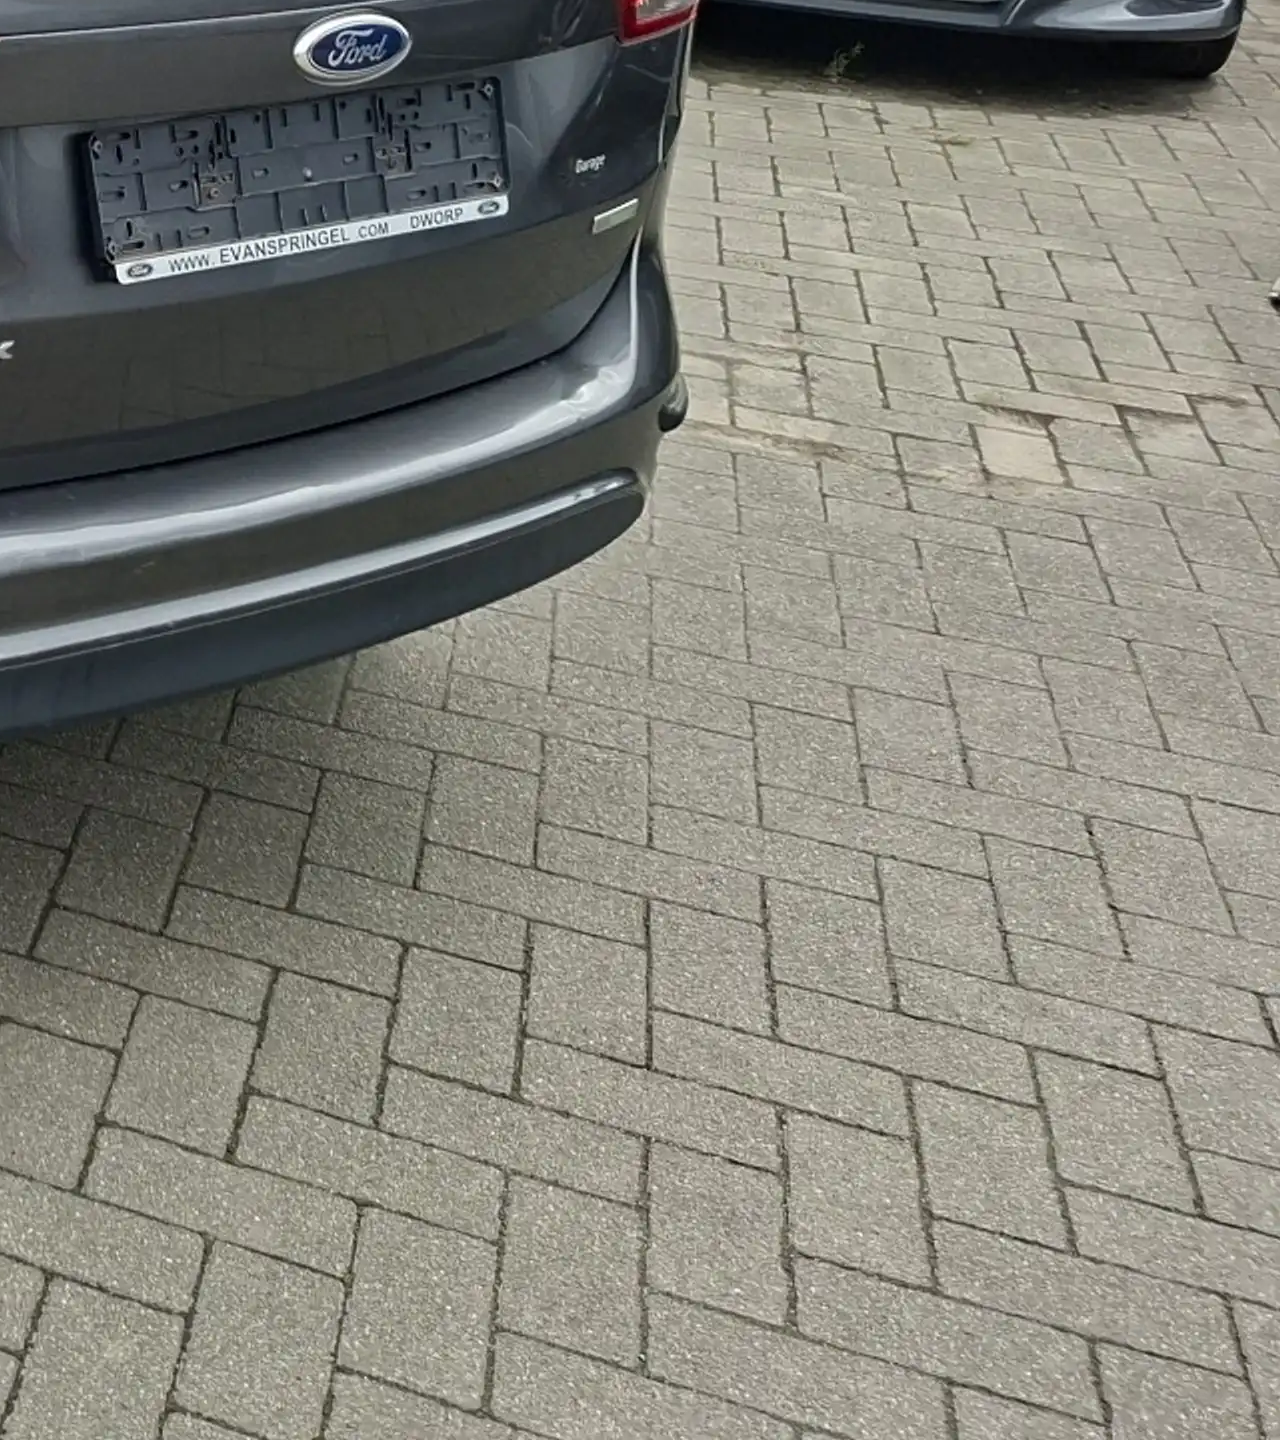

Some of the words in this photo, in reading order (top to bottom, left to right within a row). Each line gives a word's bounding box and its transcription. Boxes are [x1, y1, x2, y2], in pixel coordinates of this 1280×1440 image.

[328, 27, 388, 67] Ford
[220, 226, 351, 264] EVANSPRINGEL
[410, 207, 463, 229] DWORP
